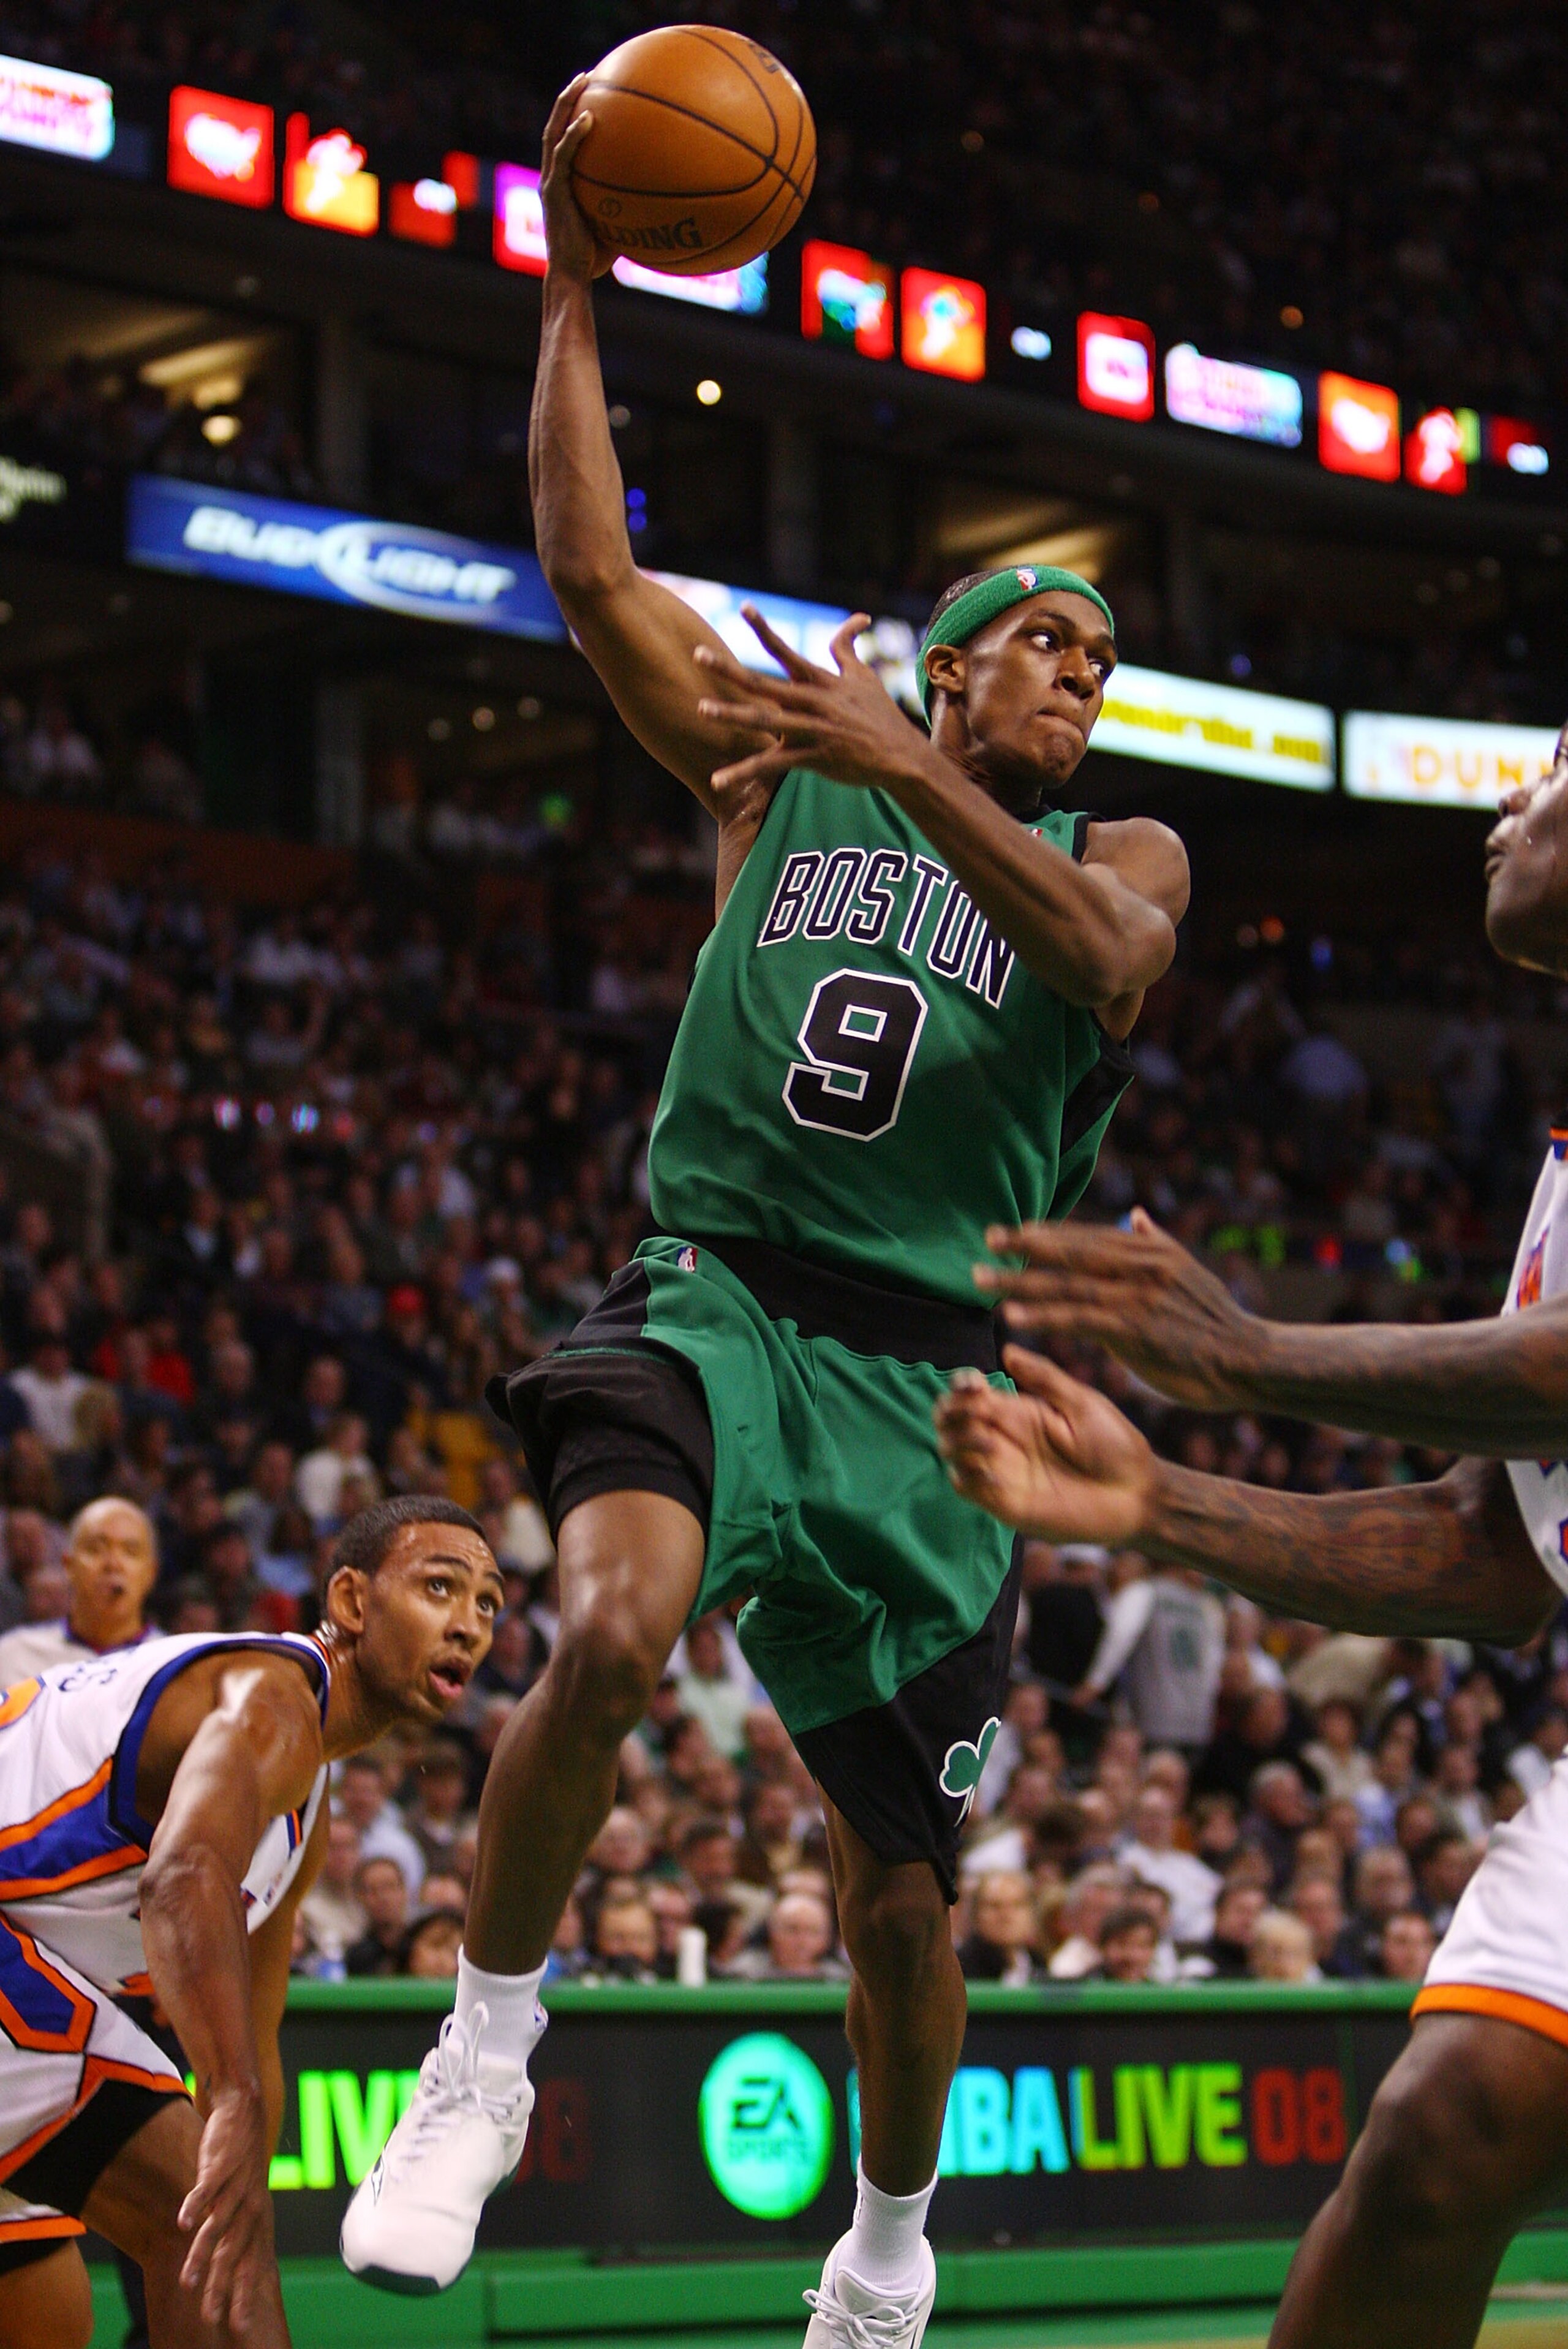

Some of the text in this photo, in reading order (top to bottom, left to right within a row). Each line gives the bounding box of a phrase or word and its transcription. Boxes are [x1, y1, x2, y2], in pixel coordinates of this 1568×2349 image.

[597, 217, 704, 250] LDING
[756, 847, 1016, 1010] BOSTON
[782, 968, 929, 1143] 9
[733, 2076, 801, 2131] EA
[1068, 2061, 1248, 2171] LIVE
[1252, 2067, 1346, 2167] 08
